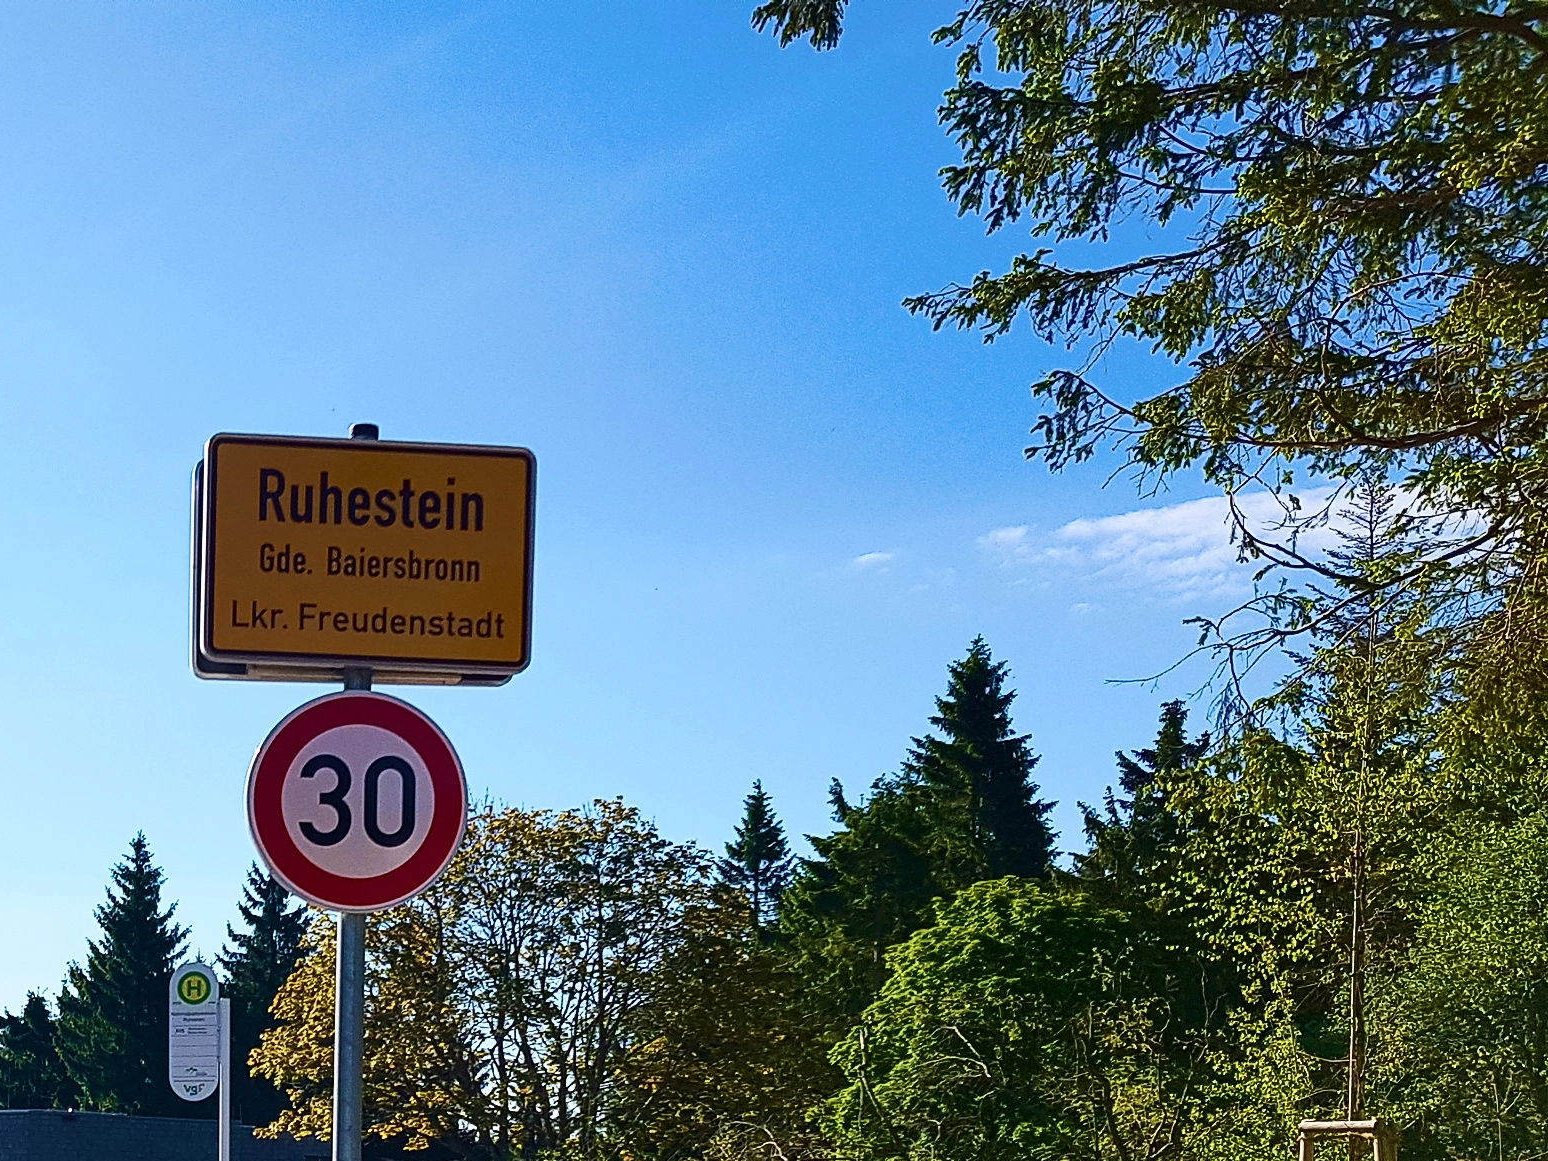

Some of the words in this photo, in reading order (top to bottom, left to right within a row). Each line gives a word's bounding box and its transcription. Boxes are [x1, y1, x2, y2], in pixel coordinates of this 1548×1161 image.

[258, 468, 485, 532] Ruhestein
[259, 543, 313, 576] Gde.
[327, 546, 481, 583] Baiersbronn
[232, 600, 288, 631] Lkr.
[299, 603, 505, 639] Freudenstadt
[299, 754, 416, 848] 30
[187, 980, 201, 997] H
